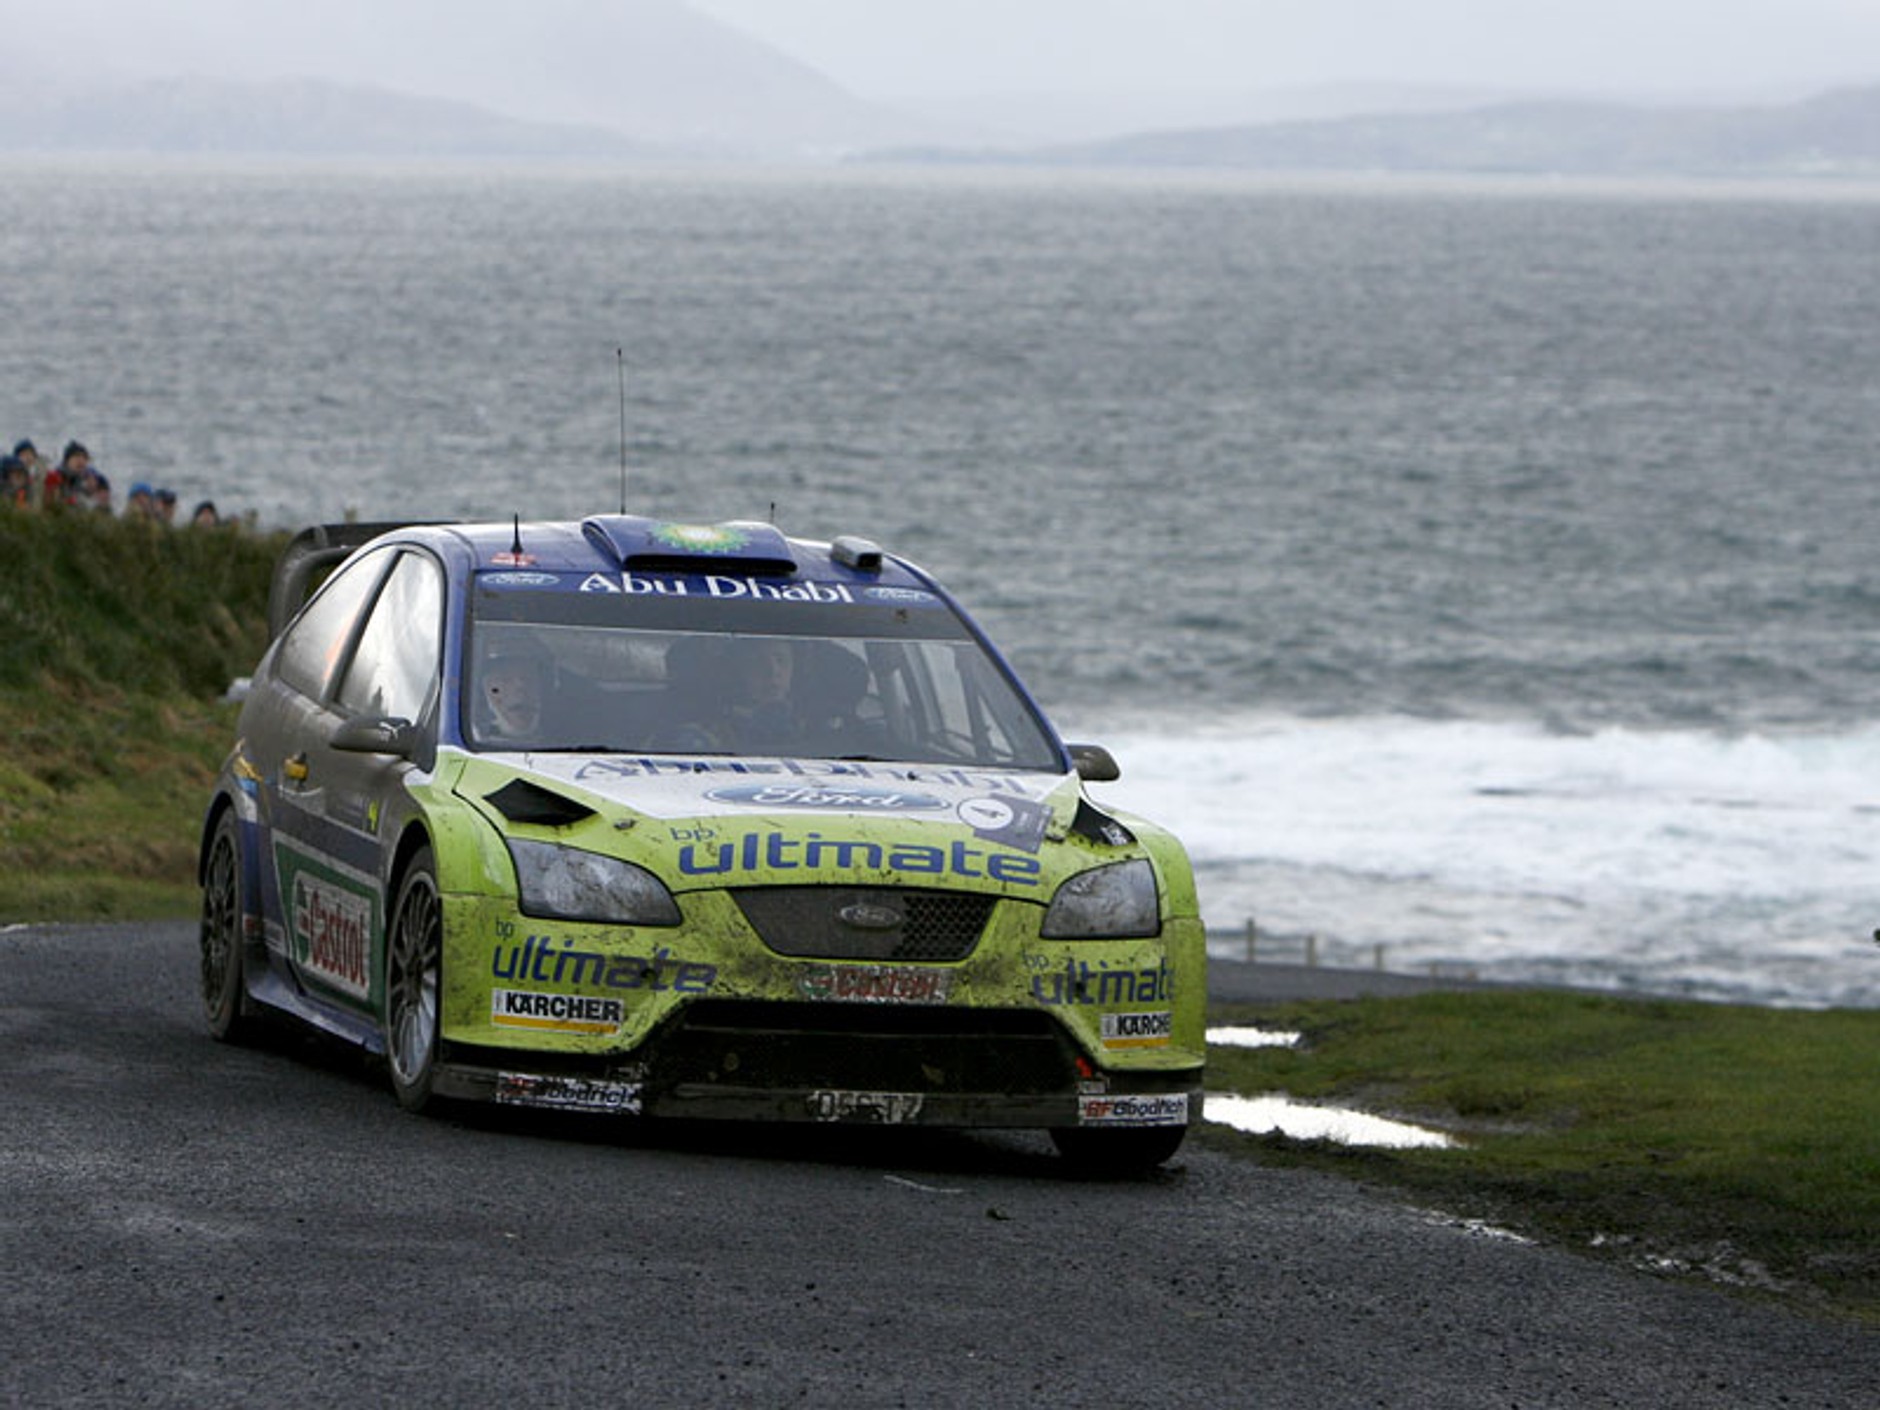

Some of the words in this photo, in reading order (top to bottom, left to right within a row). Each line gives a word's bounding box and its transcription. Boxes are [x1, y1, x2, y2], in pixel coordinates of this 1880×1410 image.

[579, 572, 687, 596] Abu
[752, 784, 904, 806] Ford
[670, 826, 716, 843] bp
[679, 832, 1042, 887] ultimate
[495, 918, 515, 940] bp
[492, 935, 718, 993] ultimate
[505, 991, 622, 1022] KÄRCHER
